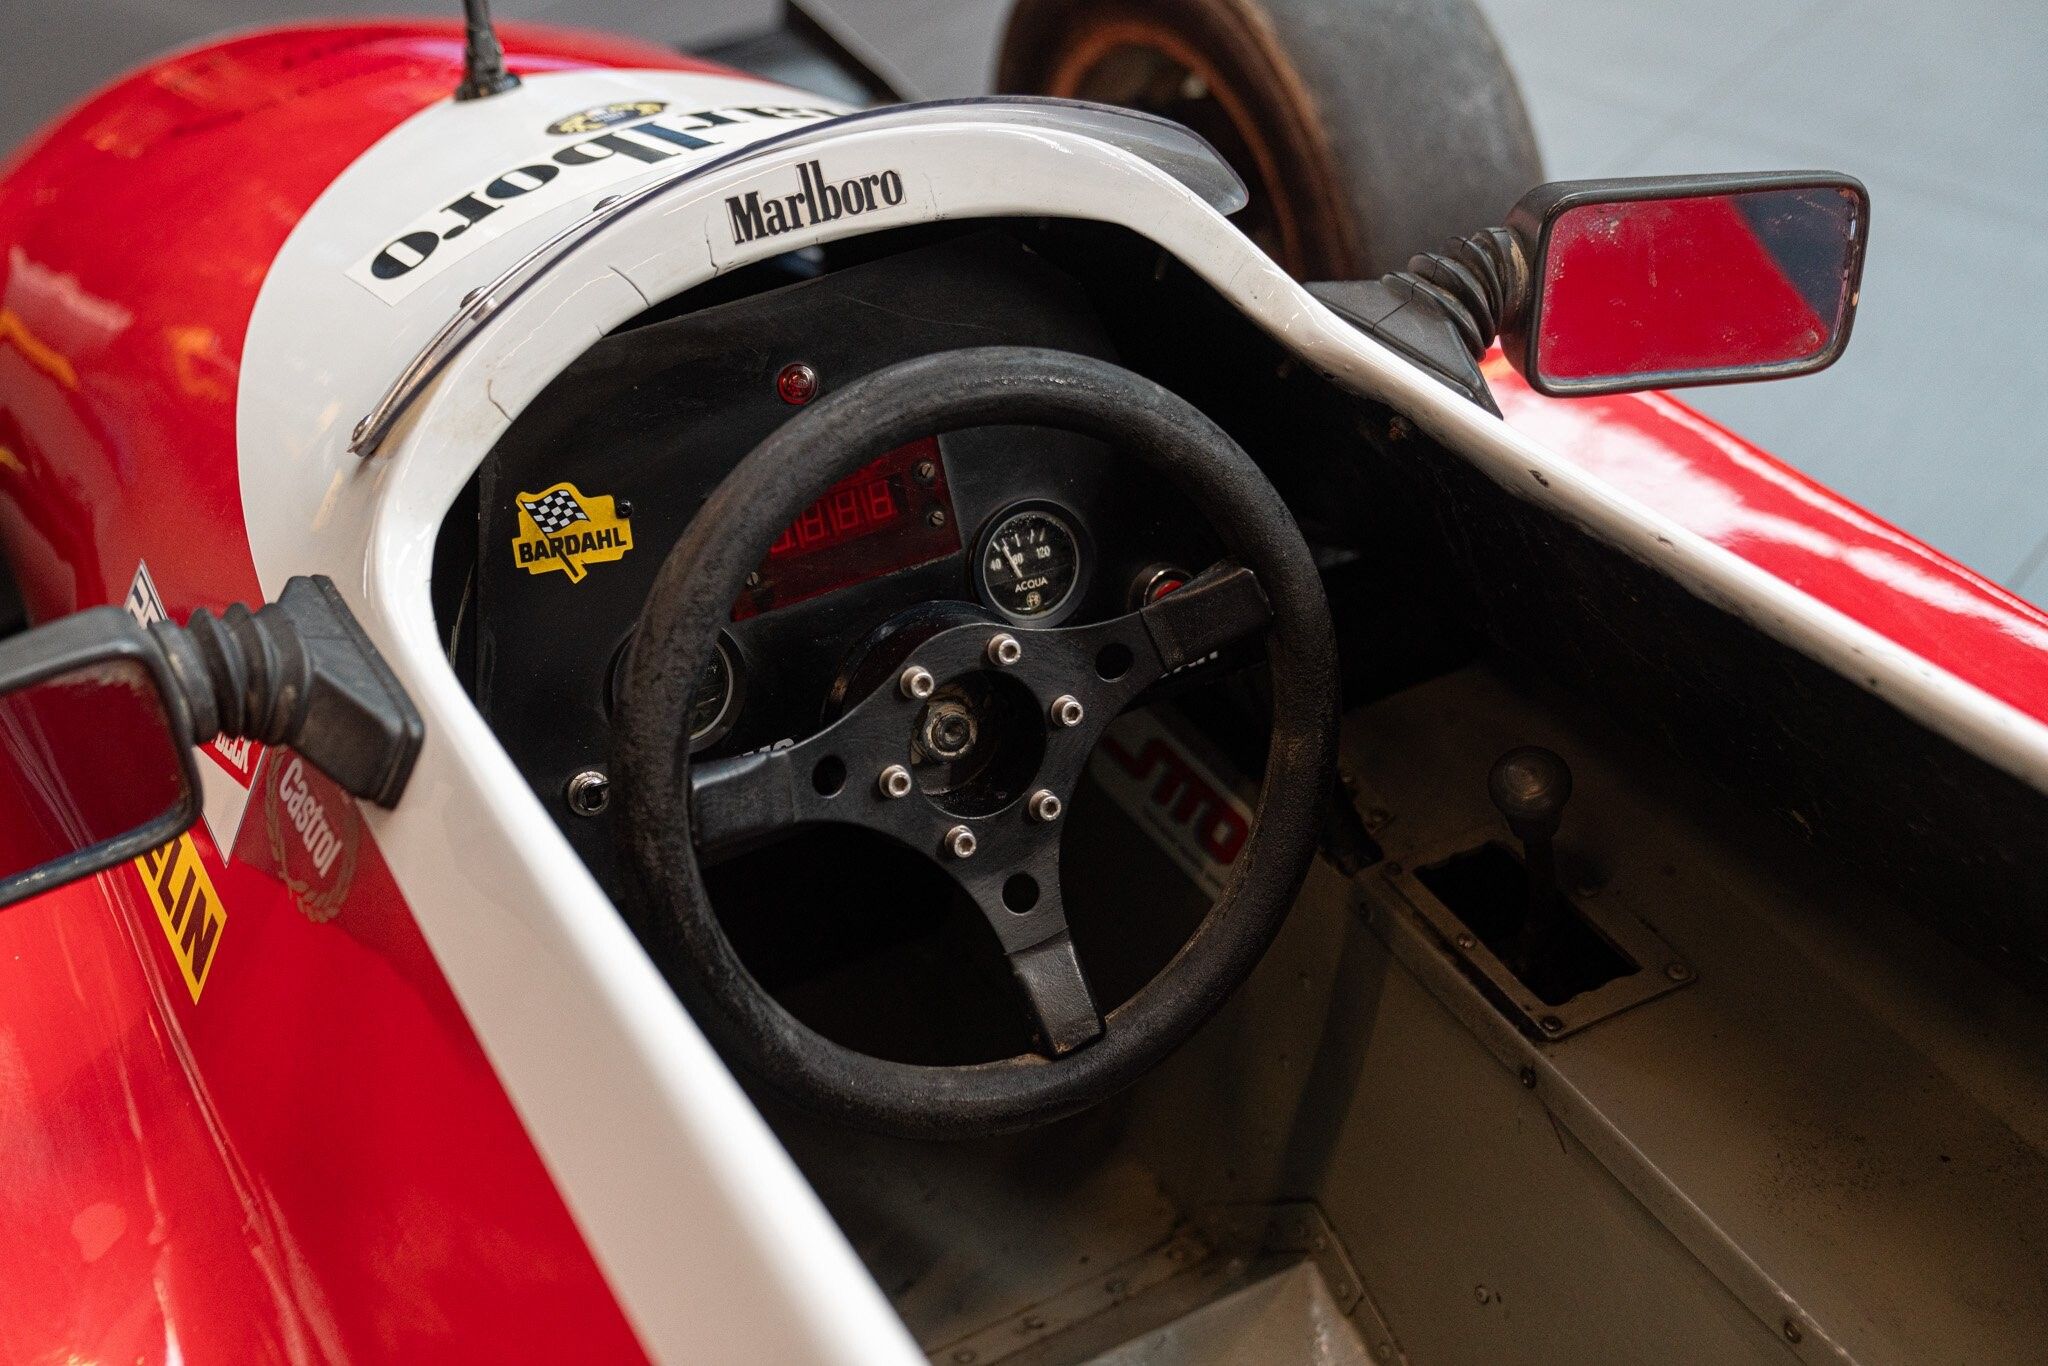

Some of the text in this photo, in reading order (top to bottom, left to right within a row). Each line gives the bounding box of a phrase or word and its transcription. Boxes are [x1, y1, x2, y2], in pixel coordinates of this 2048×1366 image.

[371, 107, 843, 280] arlboro
[725, 160, 903, 245] Marlboro
[518, 527, 628, 563] BARDAHL
[1036, 545, 1050, 559] 120
[1014, 577, 1048, 593] ACQUA
[279, 757, 344, 879] Castrol
